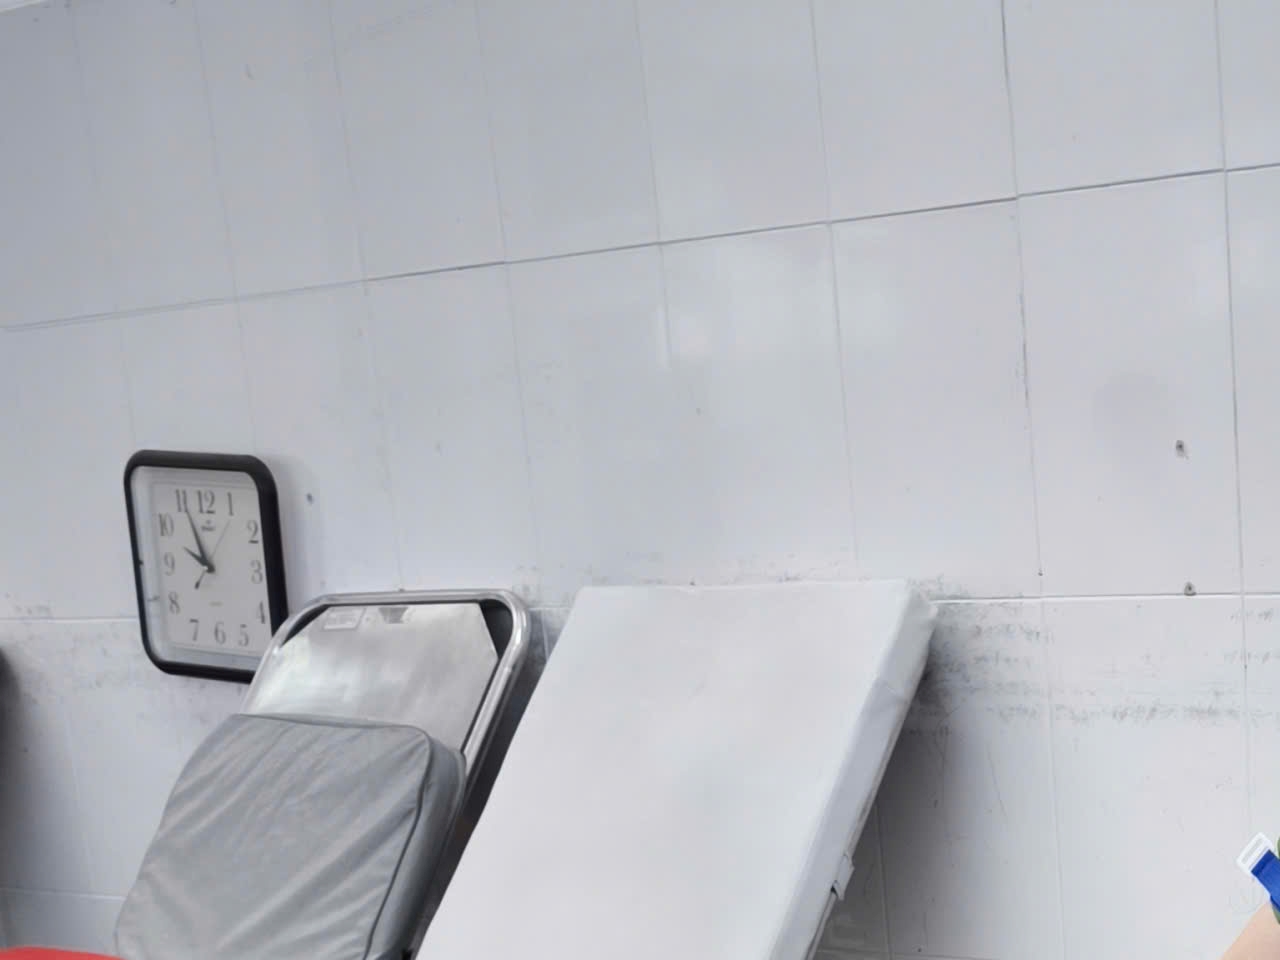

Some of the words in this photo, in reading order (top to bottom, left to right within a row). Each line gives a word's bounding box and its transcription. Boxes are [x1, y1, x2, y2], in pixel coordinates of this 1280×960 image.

[175, 488, 189, 513] 11
[196, 489, 216, 514] 12
[227, 491, 235, 517] 1
[157, 513, 175, 537] 10
[246, 519, 260, 544] 2
[163, 552, 176, 577] 9
[250, 560, 264, 585] 3
[168, 590, 181, 615] 8
[189, 618, 200, 642] 7
[213, 620, 227, 645] 6
[238, 623, 250, 647] 5
